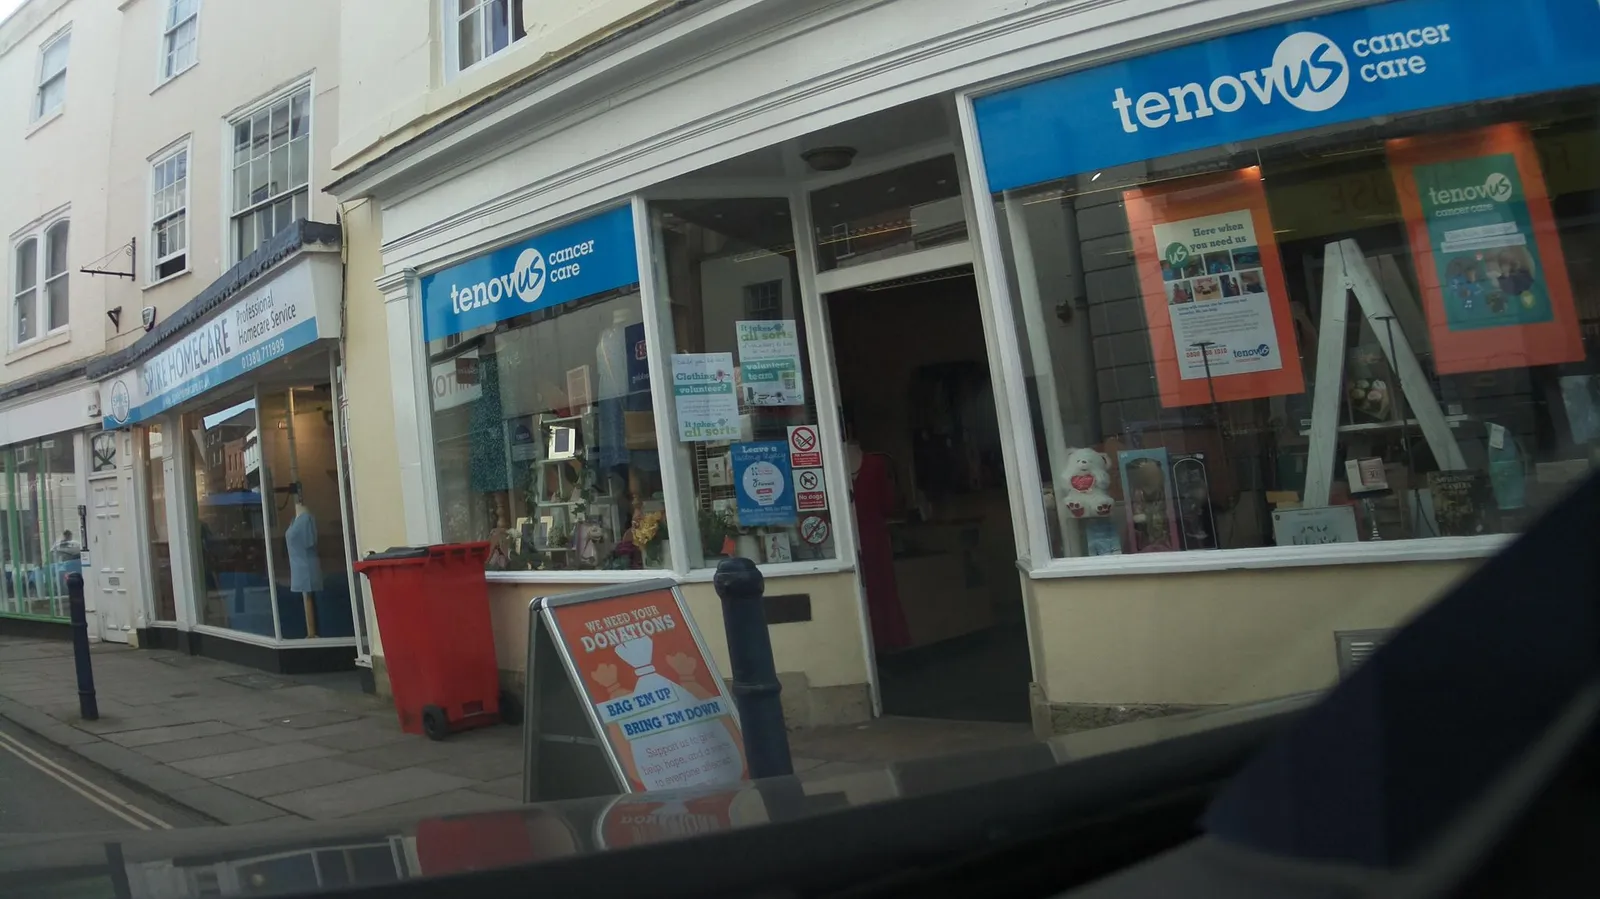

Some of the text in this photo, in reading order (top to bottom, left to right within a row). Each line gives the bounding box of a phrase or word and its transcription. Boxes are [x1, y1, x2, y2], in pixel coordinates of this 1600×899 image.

[1353, 23, 1451, 57] cancer
[1360, 54, 1427, 82] care
[1112, 32, 1348, 133] tenovus
[1428, 173, 1512, 206] tenovus
[1436, 202, 1494, 217] cancer care
[1192, 222, 1245, 238] Here when
[549, 239, 595, 265] cancer
[1189, 235, 1247, 253] you need us
[451, 249, 546, 315] tenovus
[550, 263, 580, 283] care
[236, 287, 274, 326] Professional
[238, 303, 297, 345] Homecare Service
[741, 330, 758, 342] all
[144, 318, 231, 397] SPIRE HOMECARE
[241, 337, 285, 369] 01380 711999
[1233, 343, 1270, 359] tenovus
[676, 372, 716, 382] Clothing
[746, 361, 790, 371] volunteer
[748, 372, 774, 381] team
[679, 383, 728, 394] volunteer?
[742, 444, 769, 454] Leave
[808, 493, 823, 501] dogs
[585, 605, 660, 633] WE NEED YOUR
[580, 614, 676, 653] DONATIONS
[606, 687, 671, 717] BAG 'EM UP
[623, 701, 721, 736] BRING 'EM DOWN
[645, 742, 679, 758] Support
[680, 740, 690, 748] us
[665, 767, 700, 784] everyone
